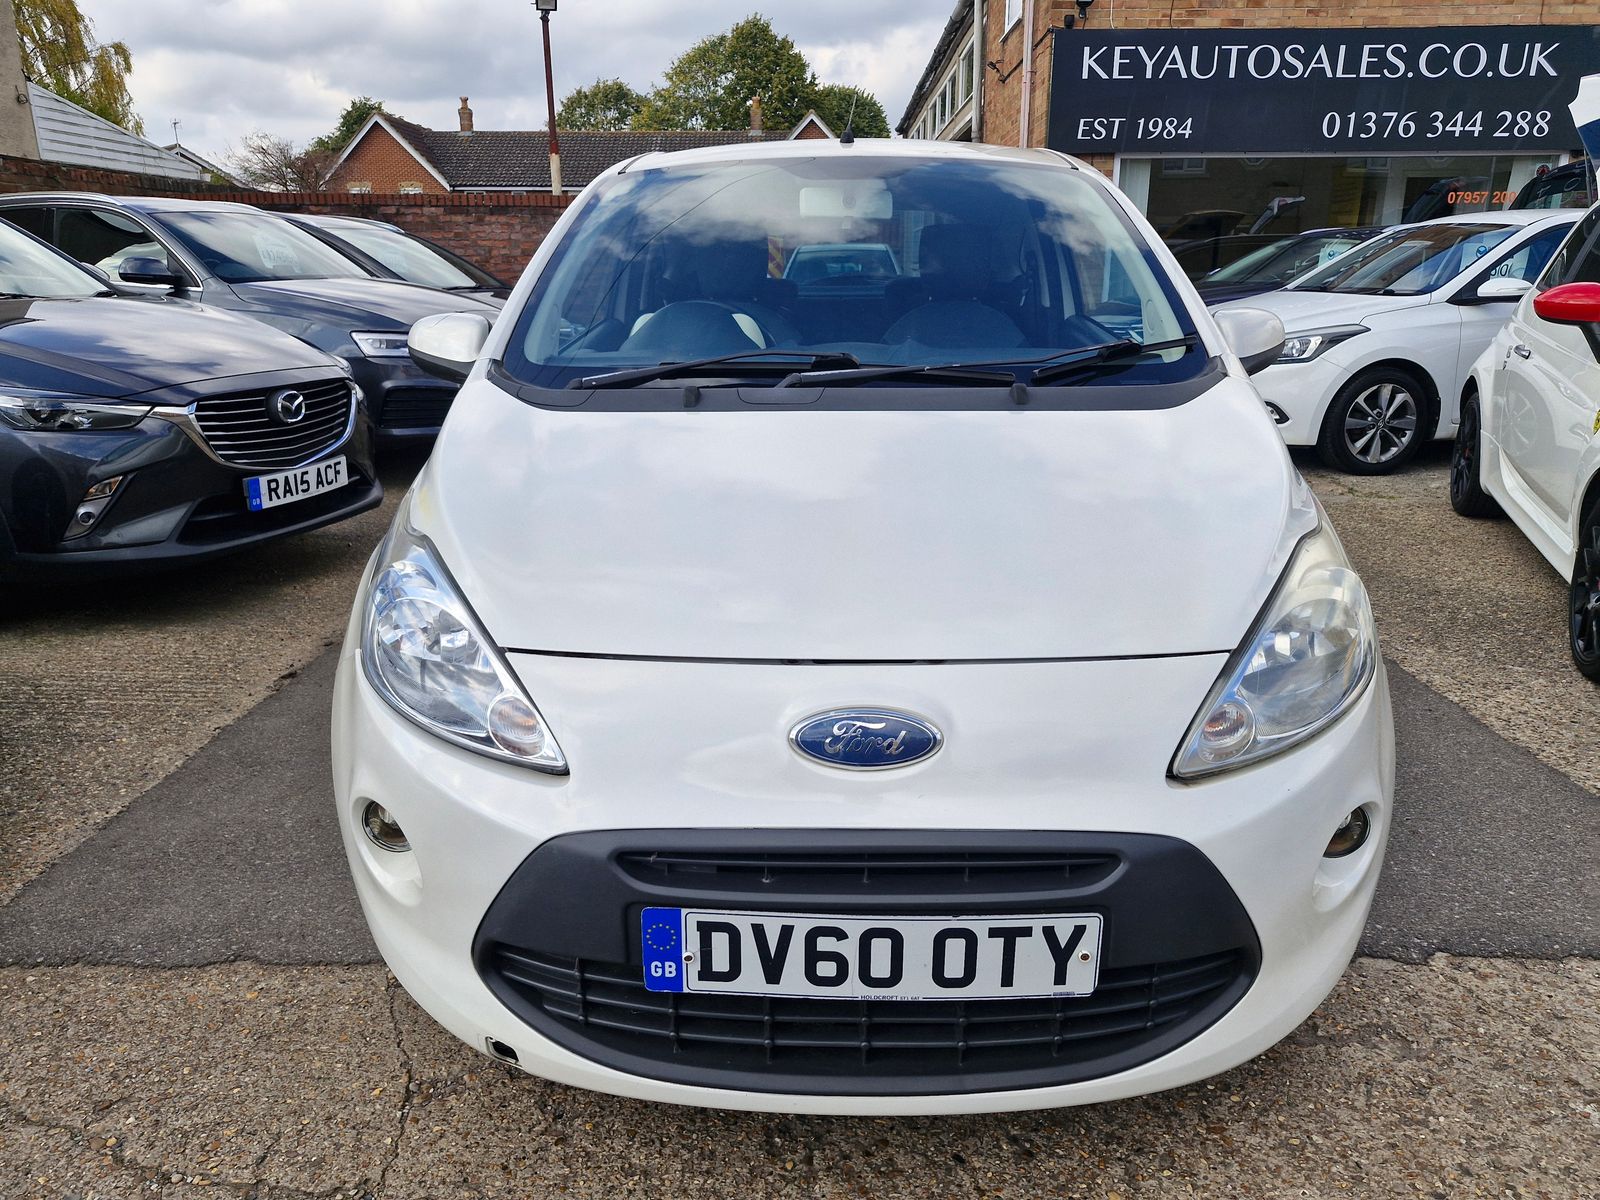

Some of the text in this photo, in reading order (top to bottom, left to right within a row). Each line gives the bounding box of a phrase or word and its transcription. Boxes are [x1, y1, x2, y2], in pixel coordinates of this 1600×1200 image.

[1081, 42, 1560, 80] KEYAUTOSALES.CO.UK
[1077, 117, 1193, 140] EST 1984
[1322, 110, 1552, 138] 01376 344 288
[1447, 191, 1489, 204] 07957
[316, 461, 342, 490] ACF
[824, 719, 907, 755] Ford
[696, 920, 905, 989] DV60
[650, 961, 677, 978] GB
